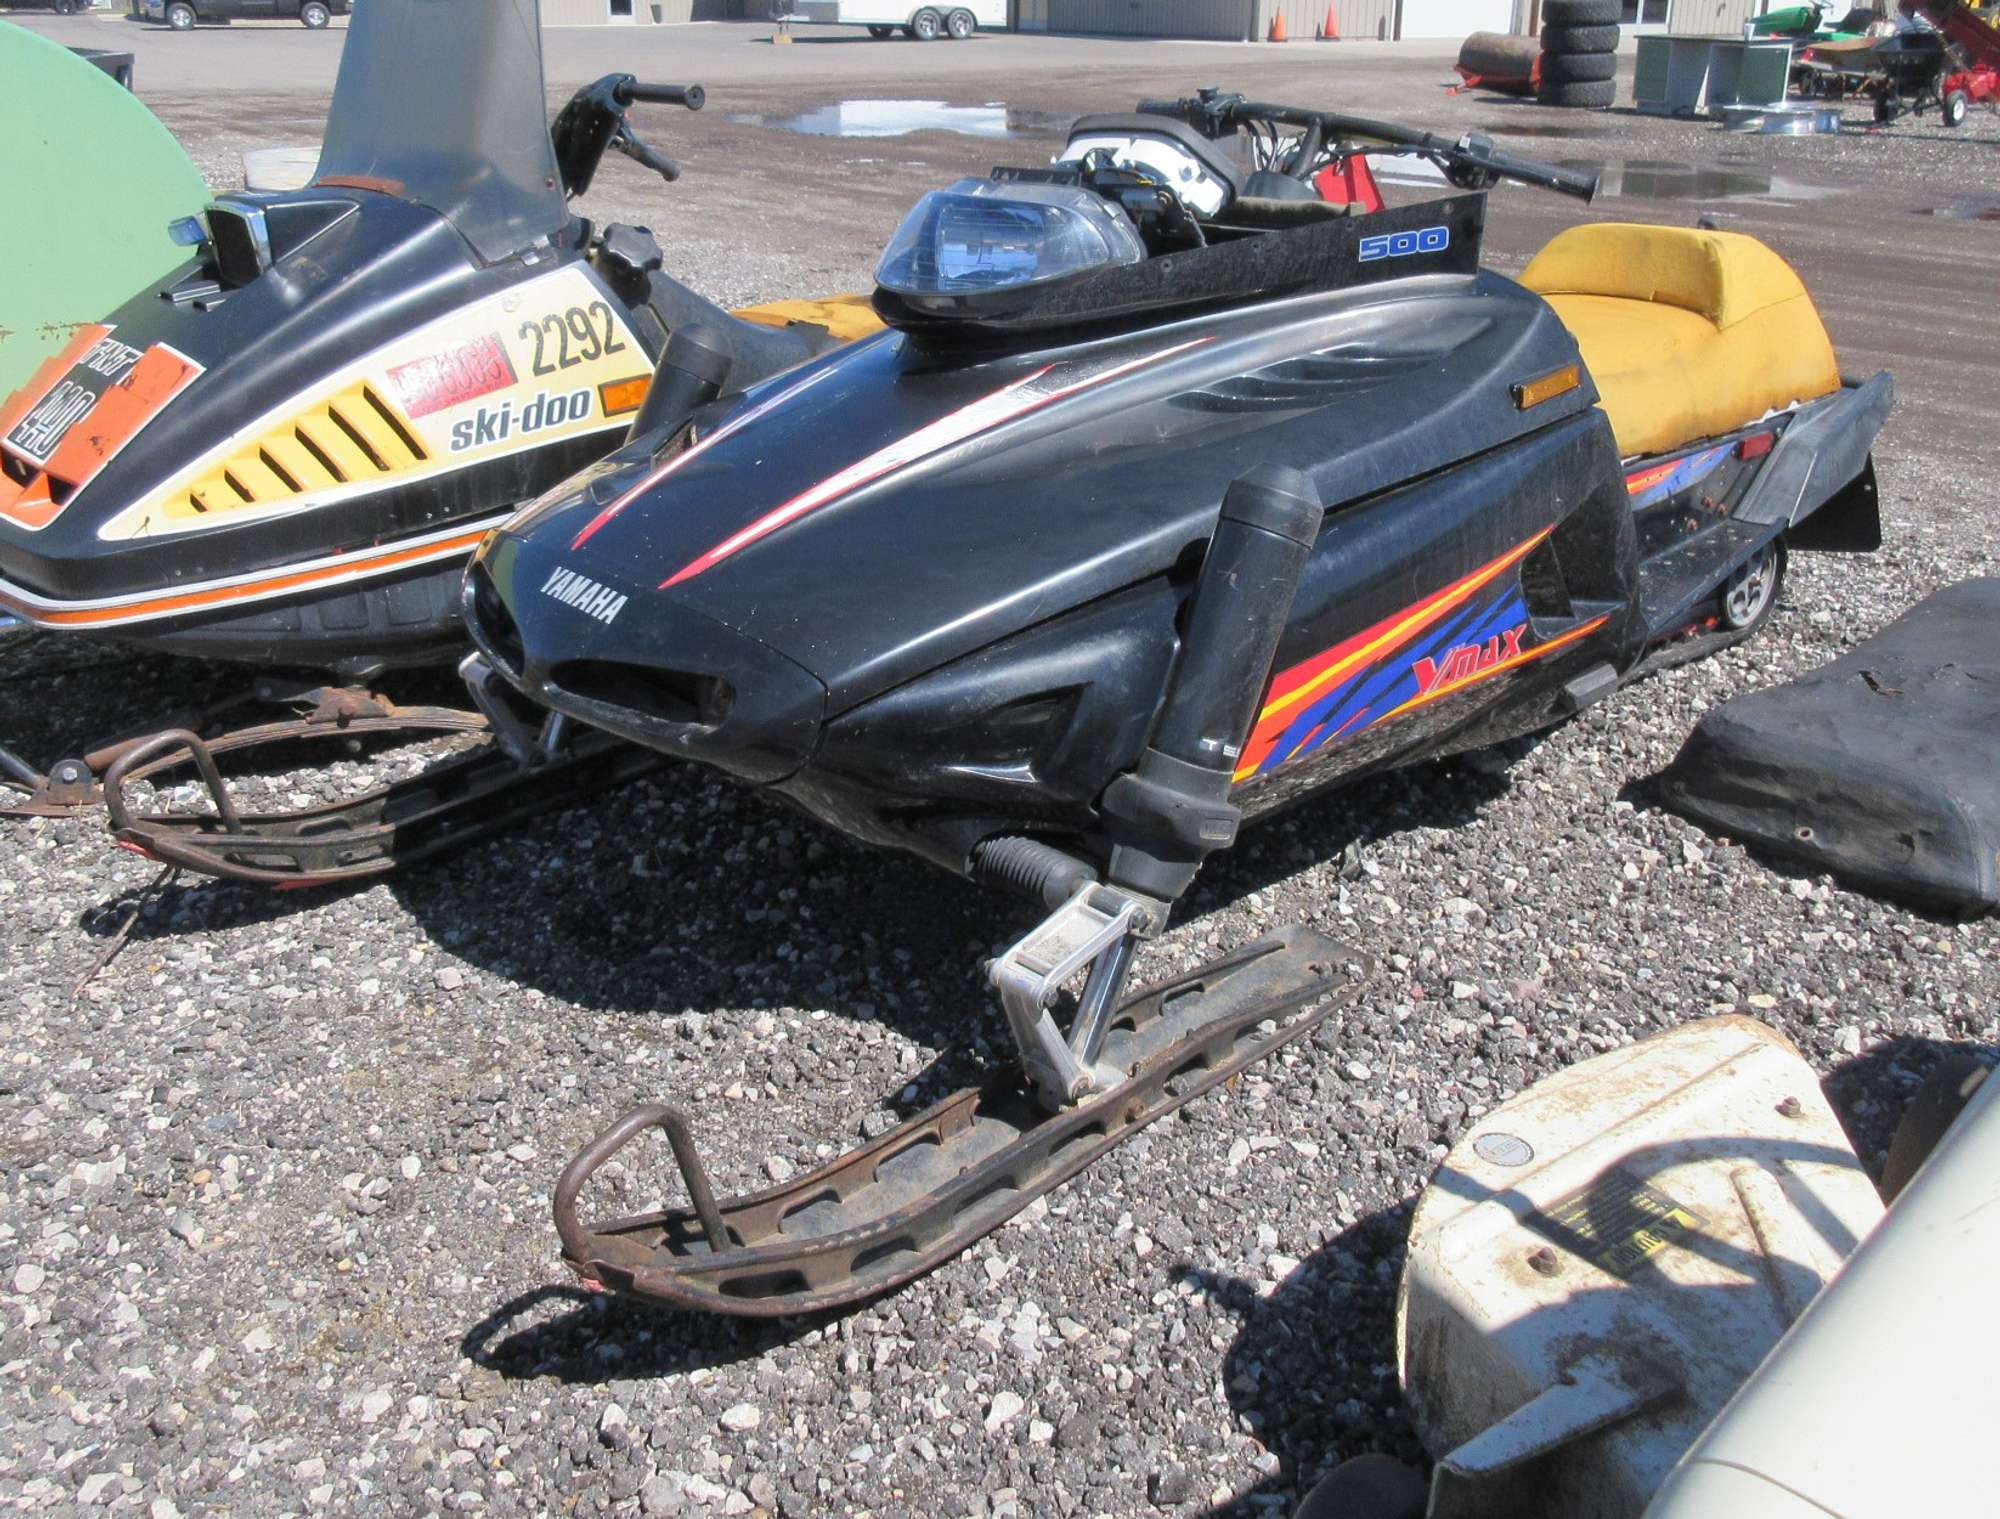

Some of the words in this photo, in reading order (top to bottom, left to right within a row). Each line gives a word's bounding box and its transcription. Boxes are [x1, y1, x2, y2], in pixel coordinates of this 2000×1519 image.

[1359, 226, 1449, 262] 500
[519, 302, 625, 376] 2292
[450, 389, 592, 452] ski-doo
[541, 566, 629, 625] YAMAHA
